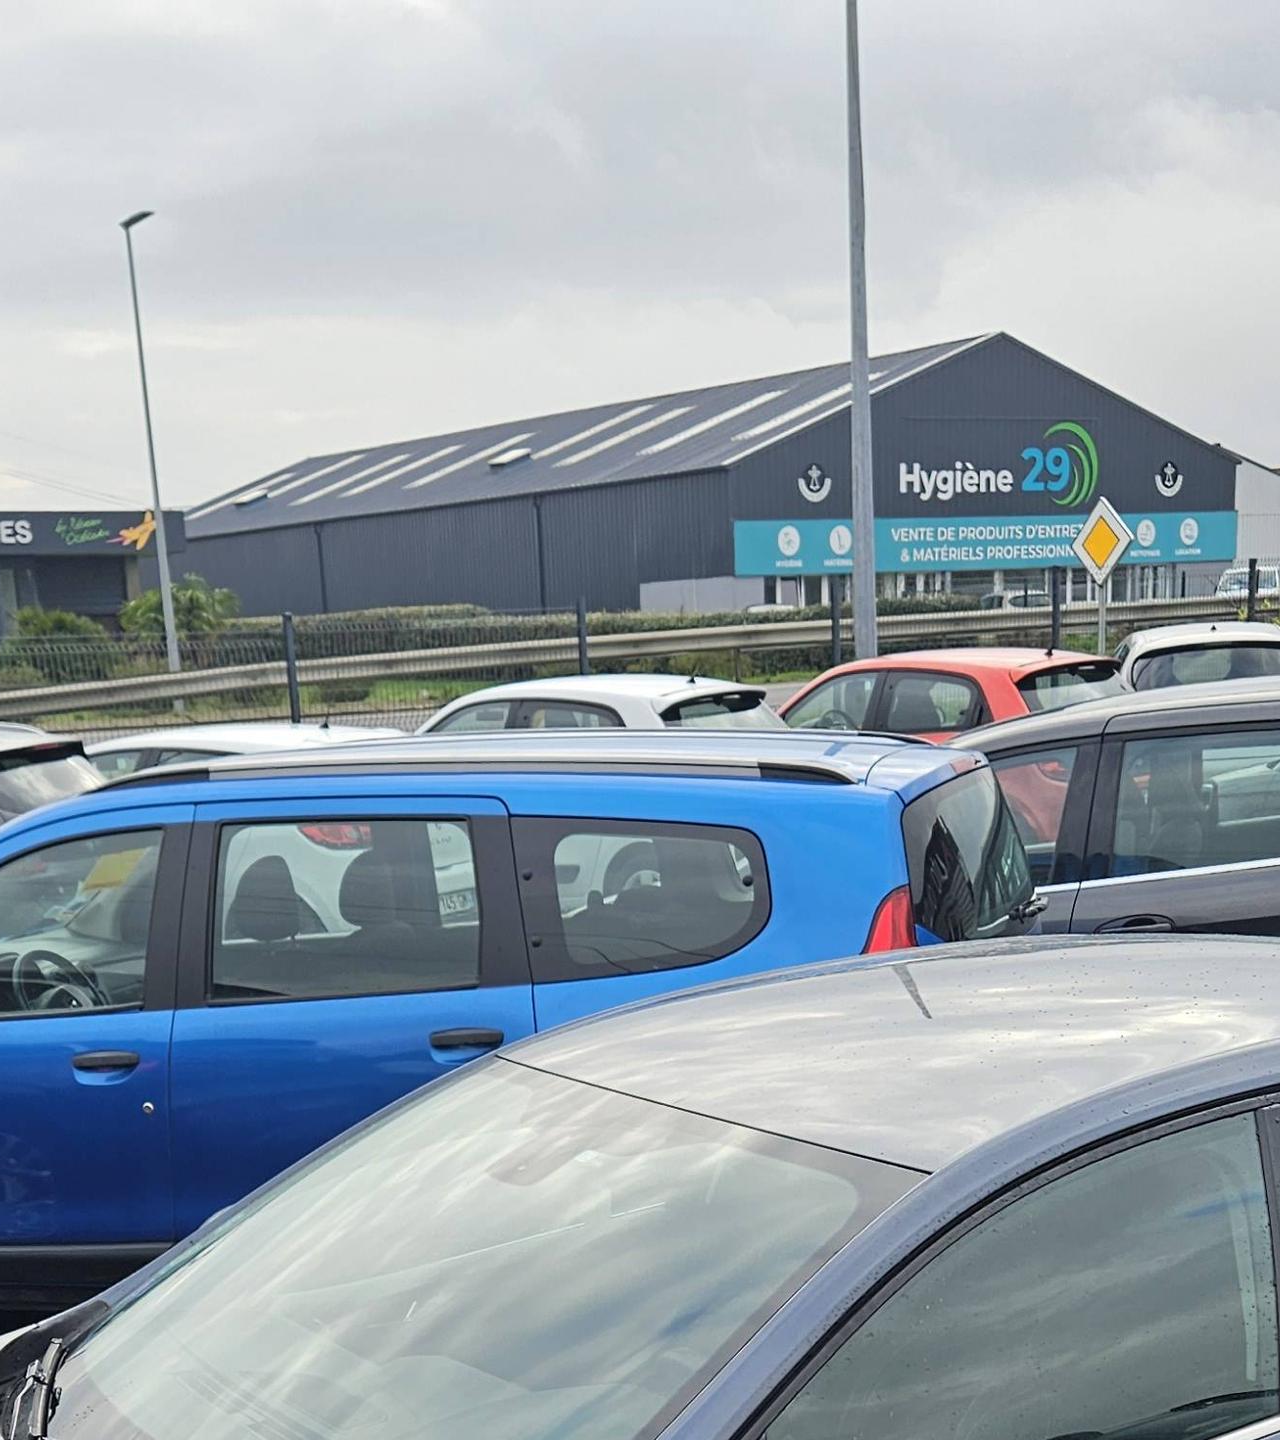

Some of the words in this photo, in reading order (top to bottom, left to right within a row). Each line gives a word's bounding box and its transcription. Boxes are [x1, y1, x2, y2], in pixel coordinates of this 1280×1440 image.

[898, 461, 1014, 501] Hygiène
[1021, 447, 1071, 492] 29
[891, 526, 934, 542] VENTE
[937, 525, 956, 541] DE
[958, 524, 1022, 540] PRODUITS
[1025, 523, 1084, 539] D'ENTRE
[900, 549, 910, 562] &
[913, 544, 984, 562] MATÉRIELS
[986, 543, 1075, 560] PROFESSIONN
